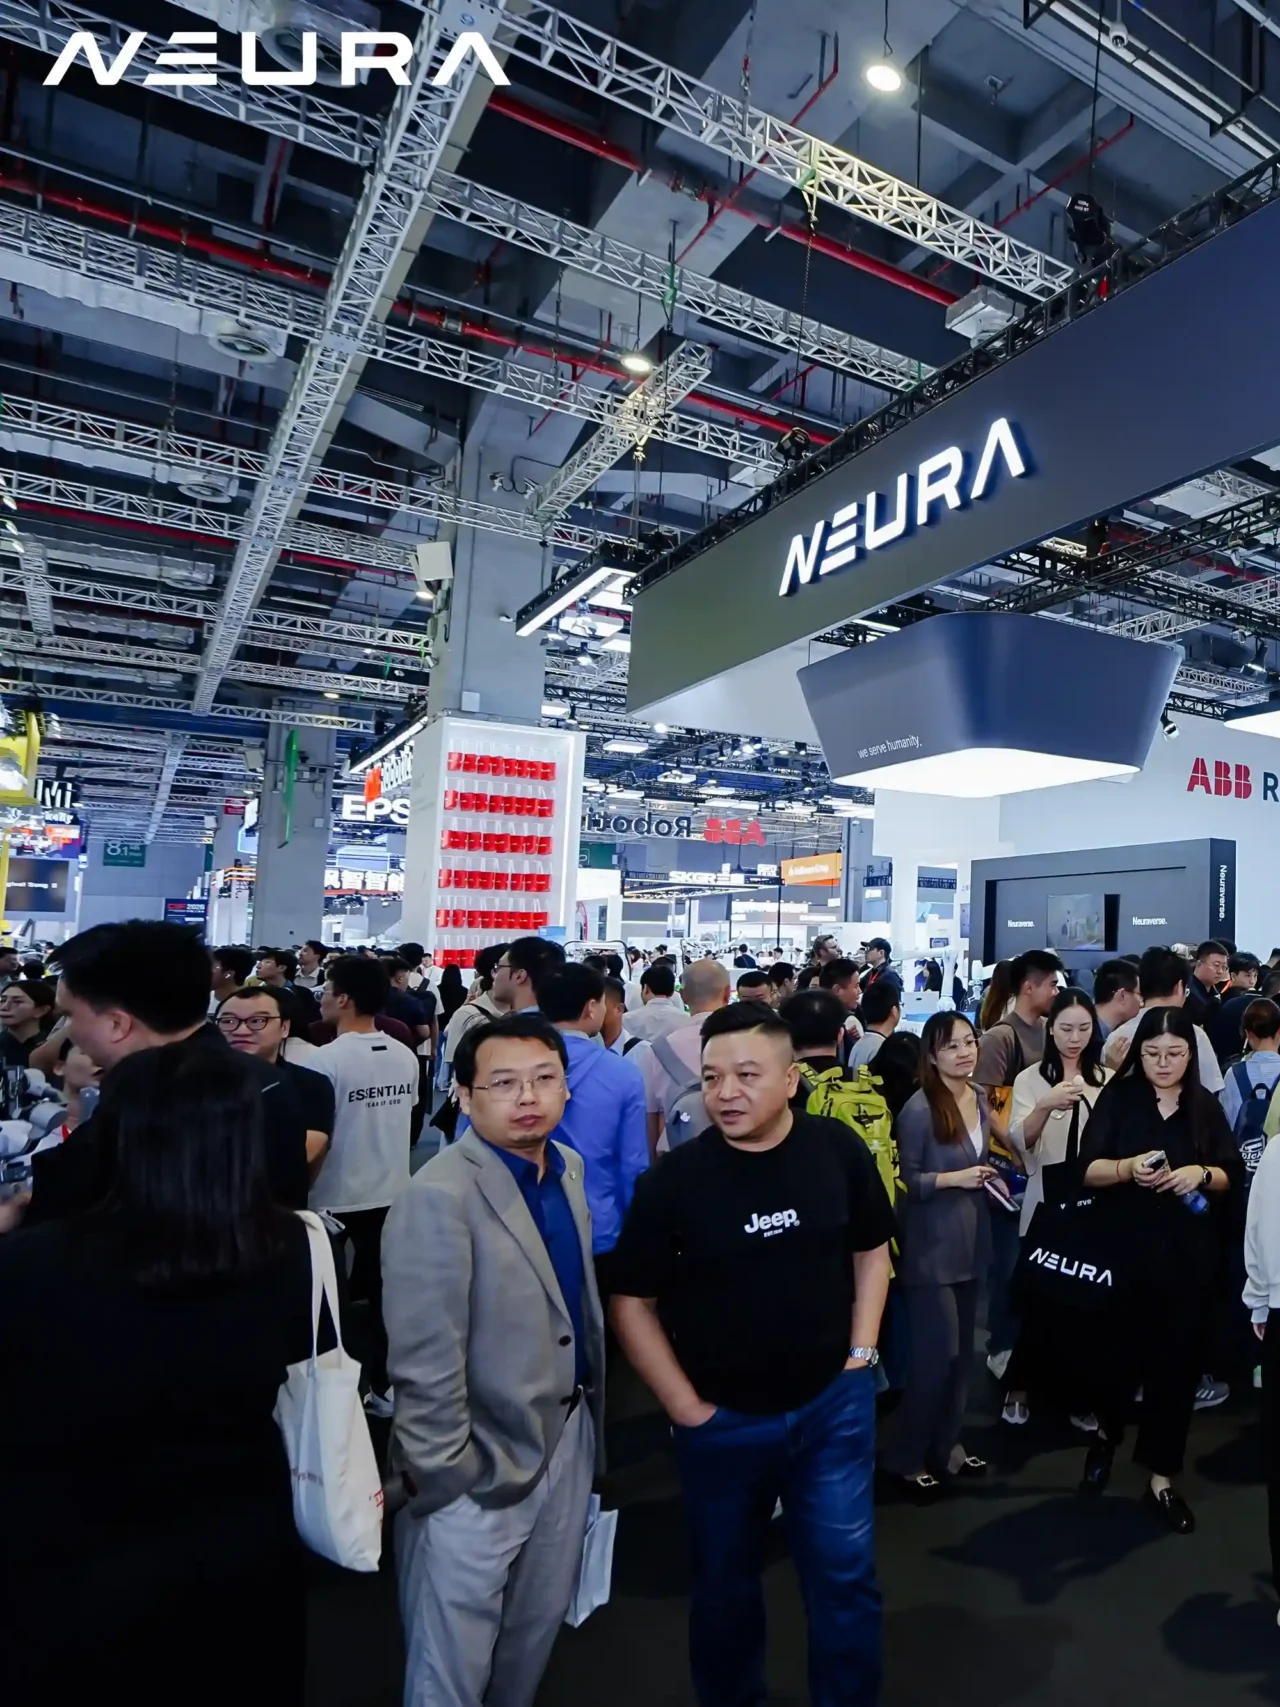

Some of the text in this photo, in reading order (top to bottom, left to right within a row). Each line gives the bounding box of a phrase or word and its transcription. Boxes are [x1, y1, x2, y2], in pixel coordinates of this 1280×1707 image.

[778, 417, 1026, 597] NEURA
[857, 734, 923, 759] we serve humanity.
[1186, 757, 1252, 800] ABB
[1218, 864, 1228, 922] Neuraverse.
[1132, 916, 1168, 927] Neuraverse.
[744, 1208, 798, 1234] Jeep
[1028, 1247, 1112, 1287] NEURA
